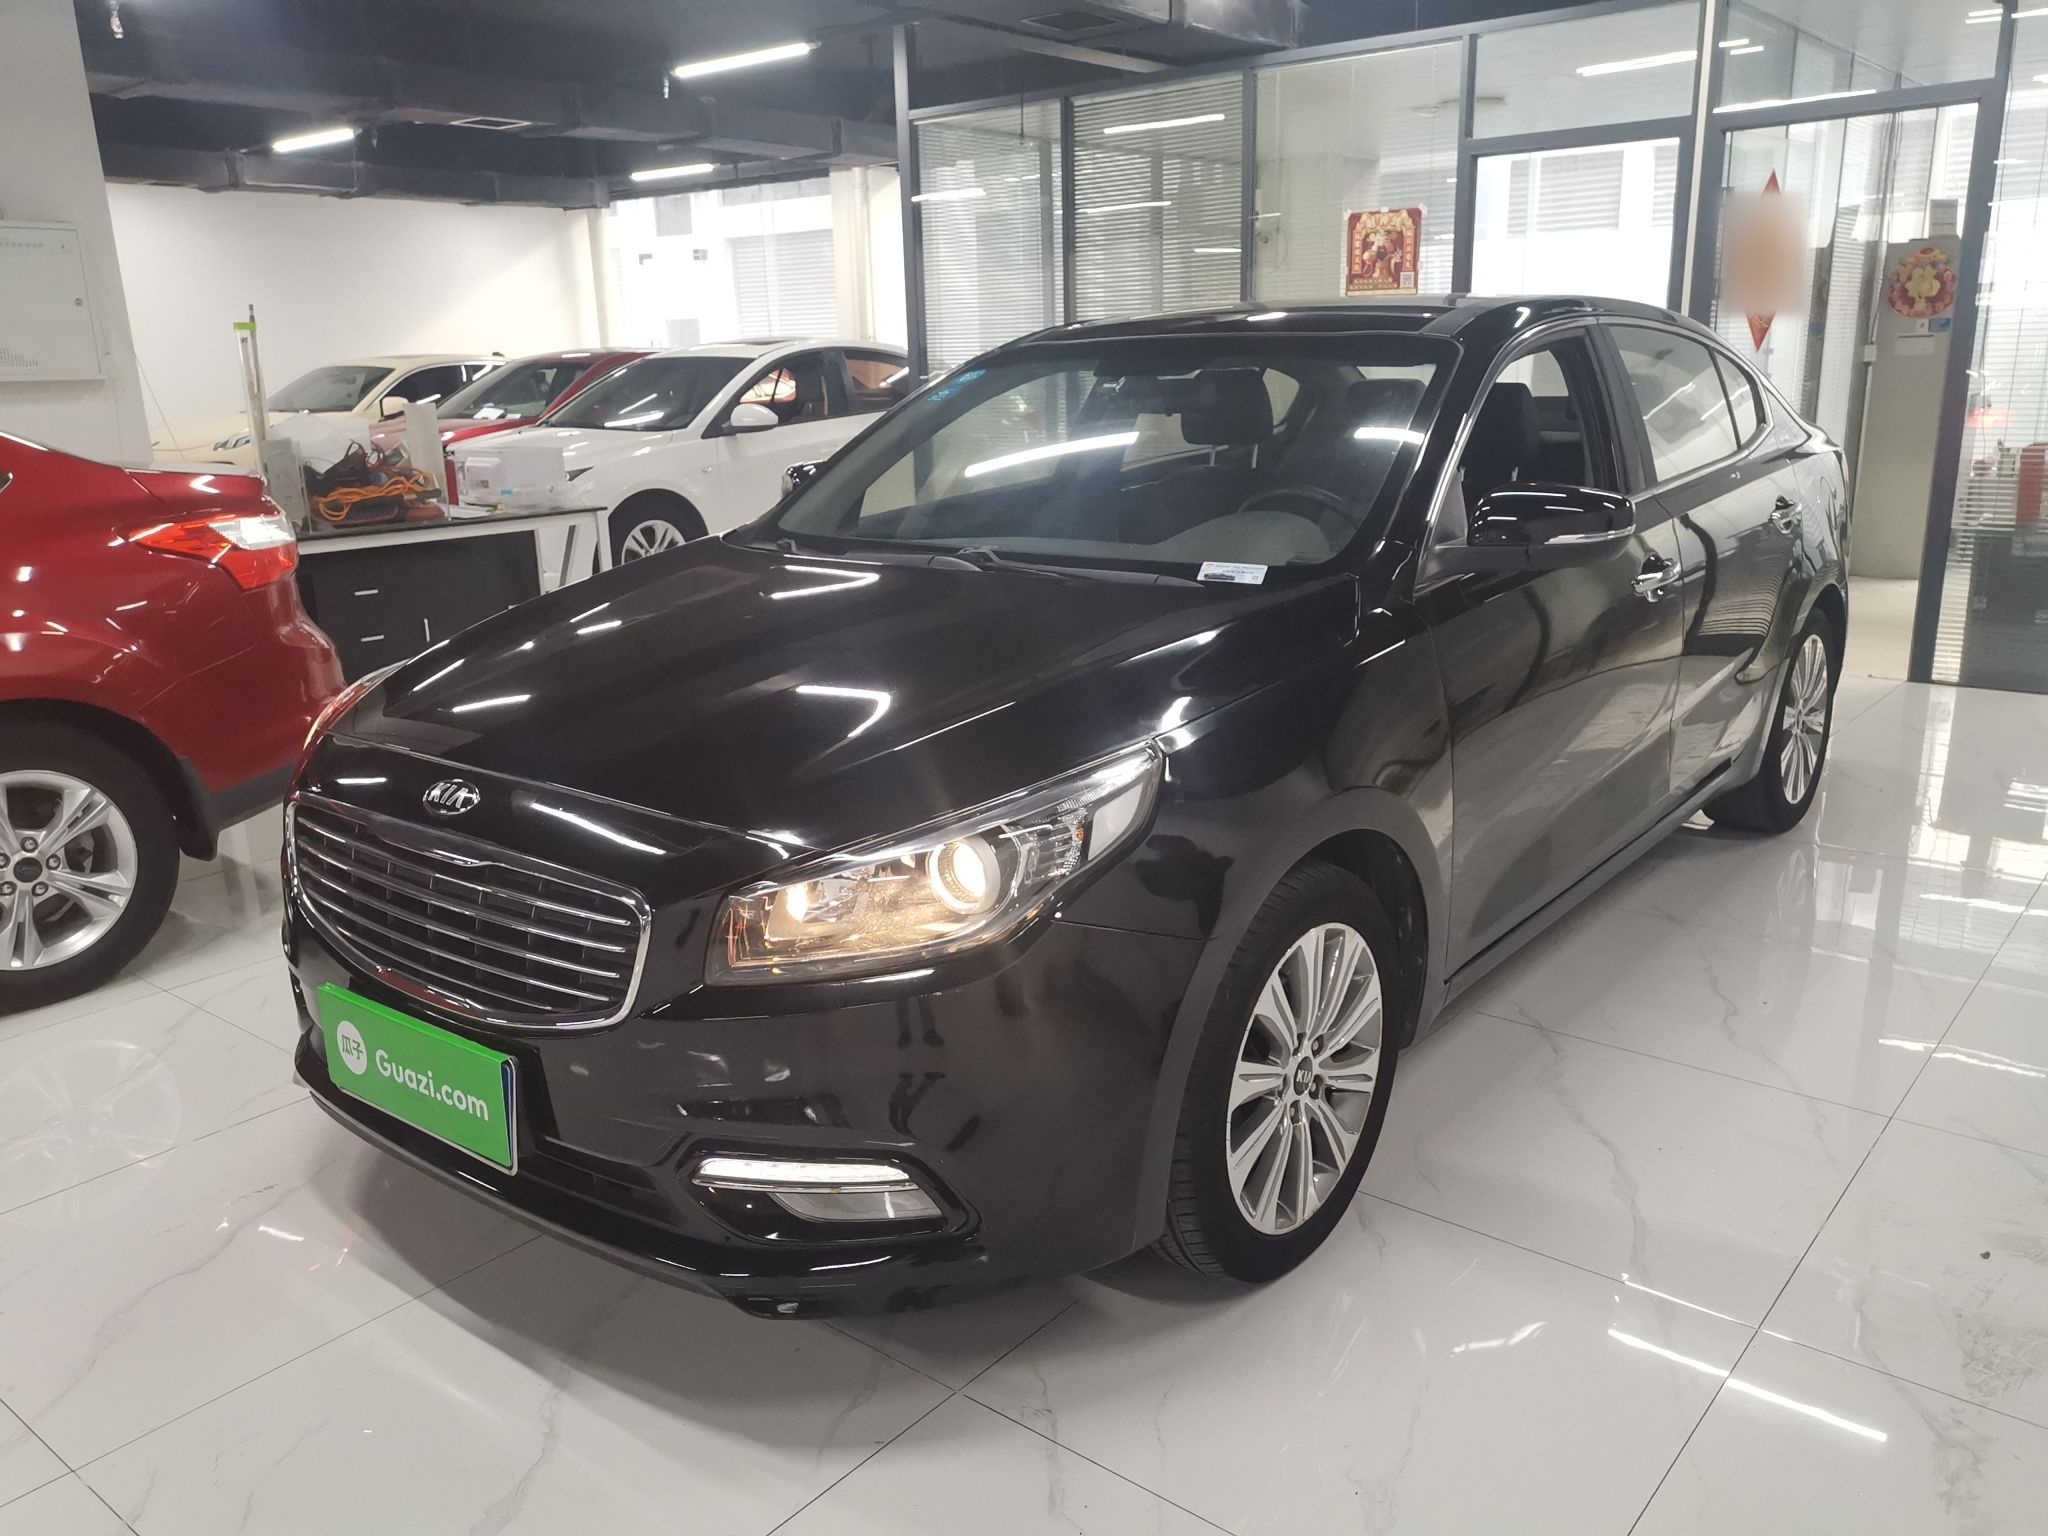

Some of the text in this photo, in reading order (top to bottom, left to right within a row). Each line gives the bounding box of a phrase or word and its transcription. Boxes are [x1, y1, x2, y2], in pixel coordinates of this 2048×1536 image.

[428, 782, 477, 808] KIA
[341, 1034, 363, 1060] 瓜子
[376, 1049, 488, 1121] Guazi.com
